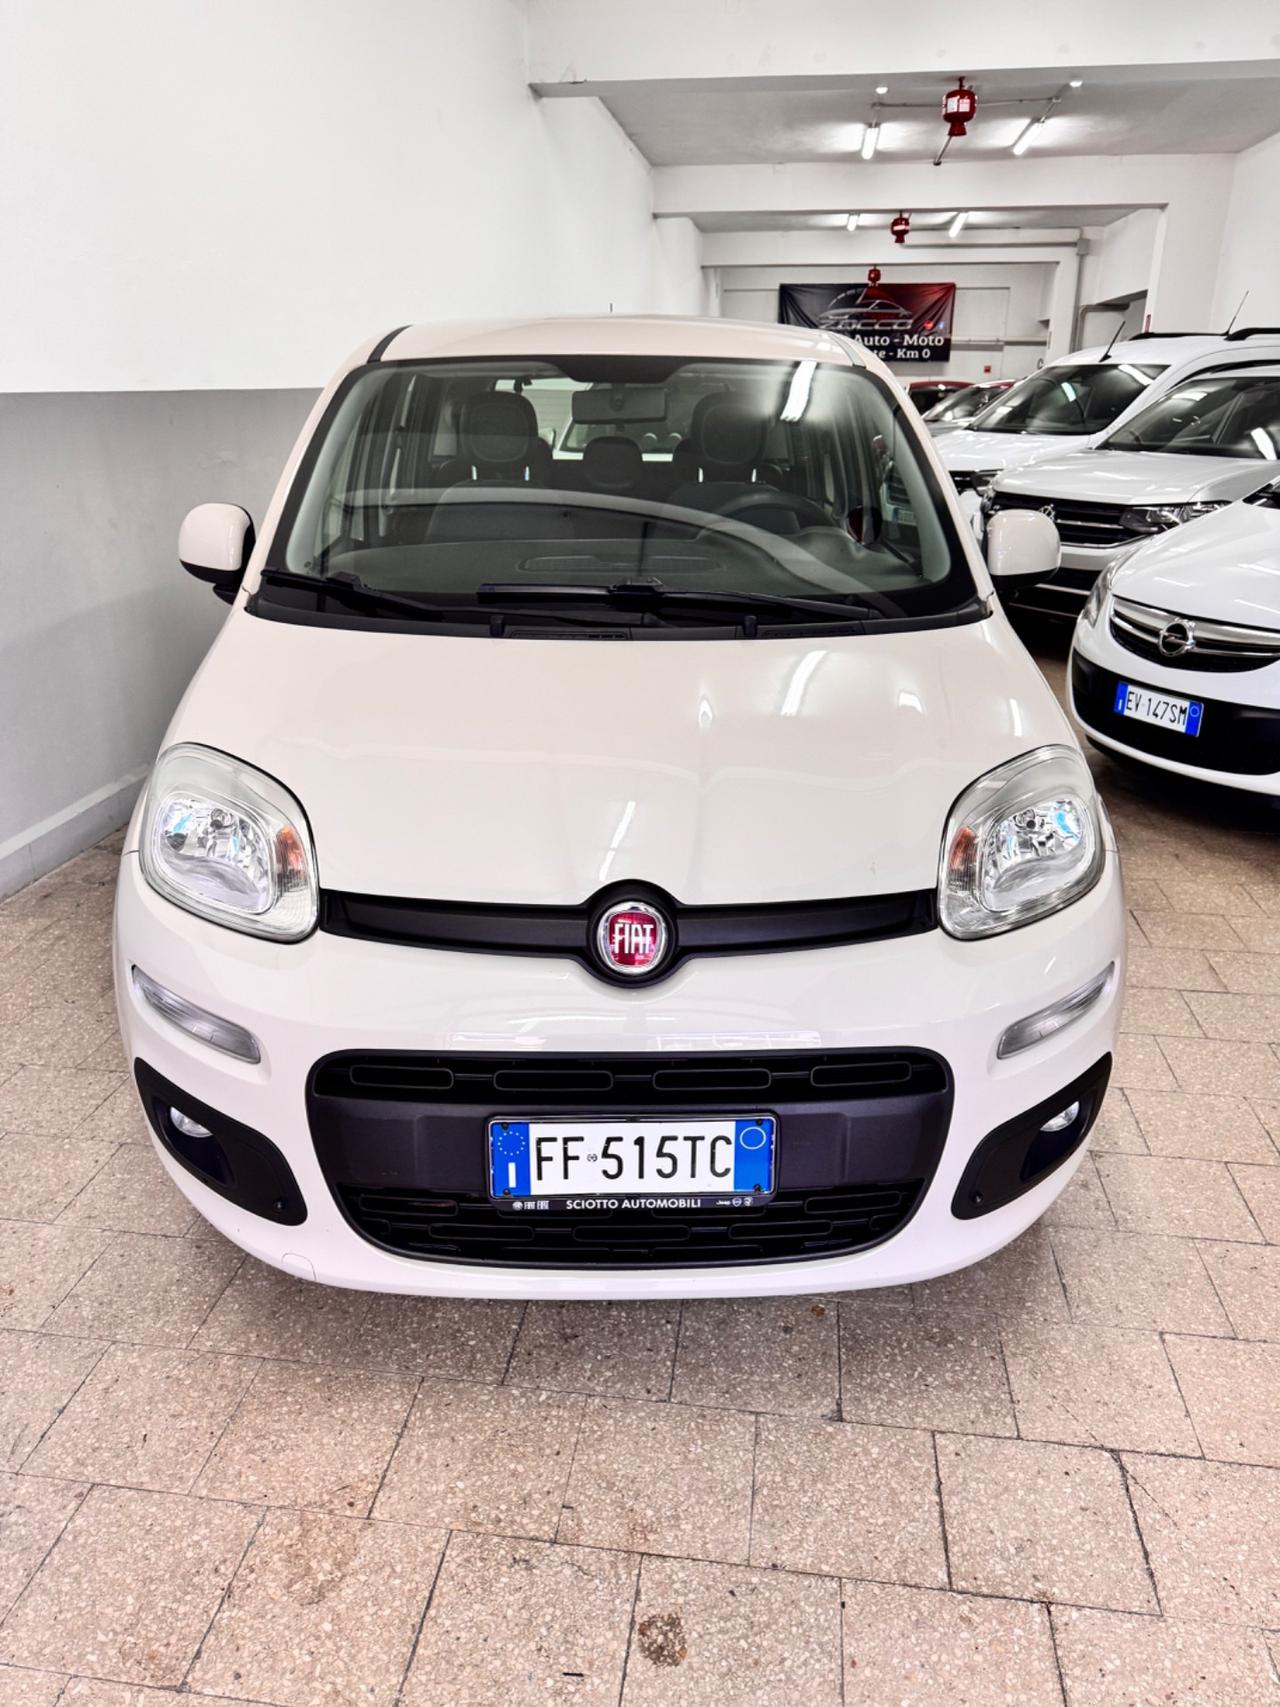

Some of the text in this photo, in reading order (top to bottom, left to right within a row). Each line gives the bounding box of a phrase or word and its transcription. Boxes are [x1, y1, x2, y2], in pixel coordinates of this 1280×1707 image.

[854, 334, 890, 347] Auto
[903, 334, 944, 346] Moto
[897, 349, 920, 358] Km
[922, 349, 931, 358] 0
[614, 923, 654, 954] FIAT
[536, 1135, 733, 1180] FF 515TC
[566, 1199, 619, 1210] SCIOTTO
[621, 1198, 701, 1208] AUTOMOBILI
